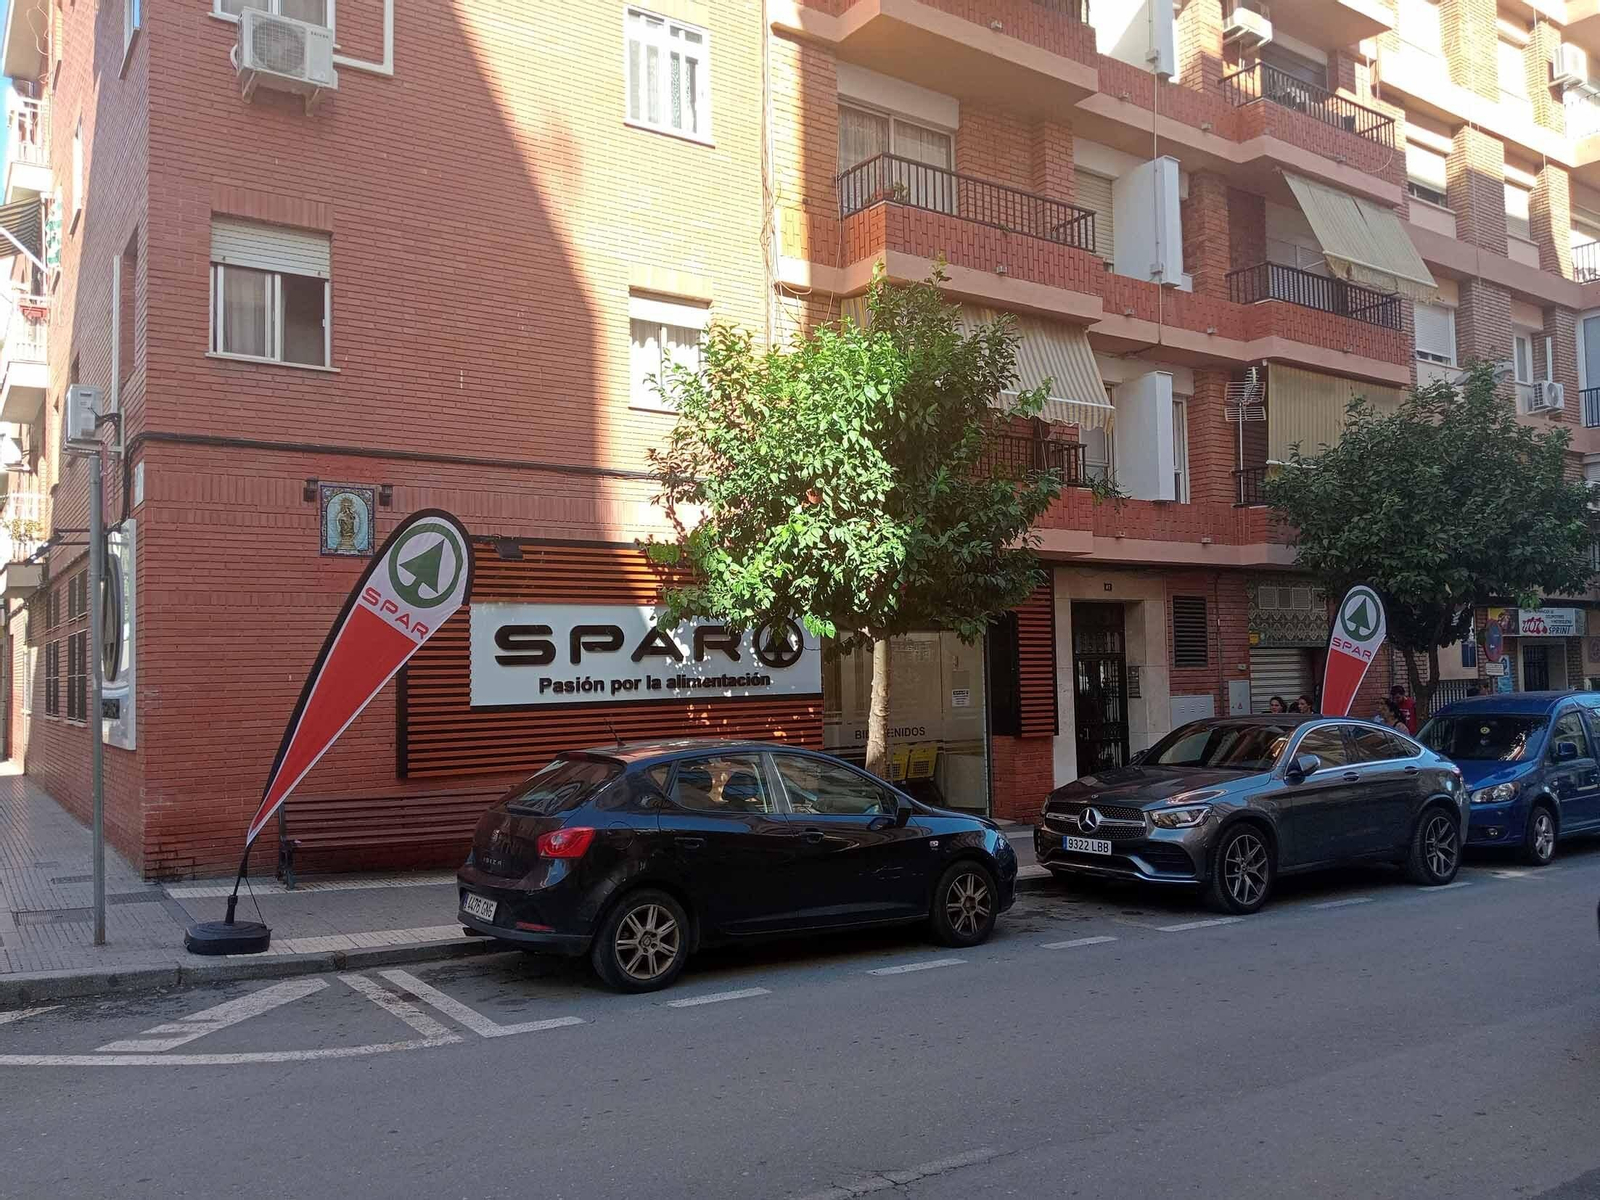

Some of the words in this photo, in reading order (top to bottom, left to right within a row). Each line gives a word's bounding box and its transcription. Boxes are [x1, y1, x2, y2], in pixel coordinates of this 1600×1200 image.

[362, 586, 430, 640] SPAR
[494, 624, 741, 667] SPAR
[1332, 637, 1371, 660] SPAR
[539, 676, 605, 694] Pasión
[610, 677, 642, 696] por
[646, 675, 662, 690] la
[666, 672, 771, 690] alimentación
[854, 726, 926, 740] BIENIDOS
[1068, 838, 1089, 850] 9322
[1091, 840, 1109, 853] LBB
